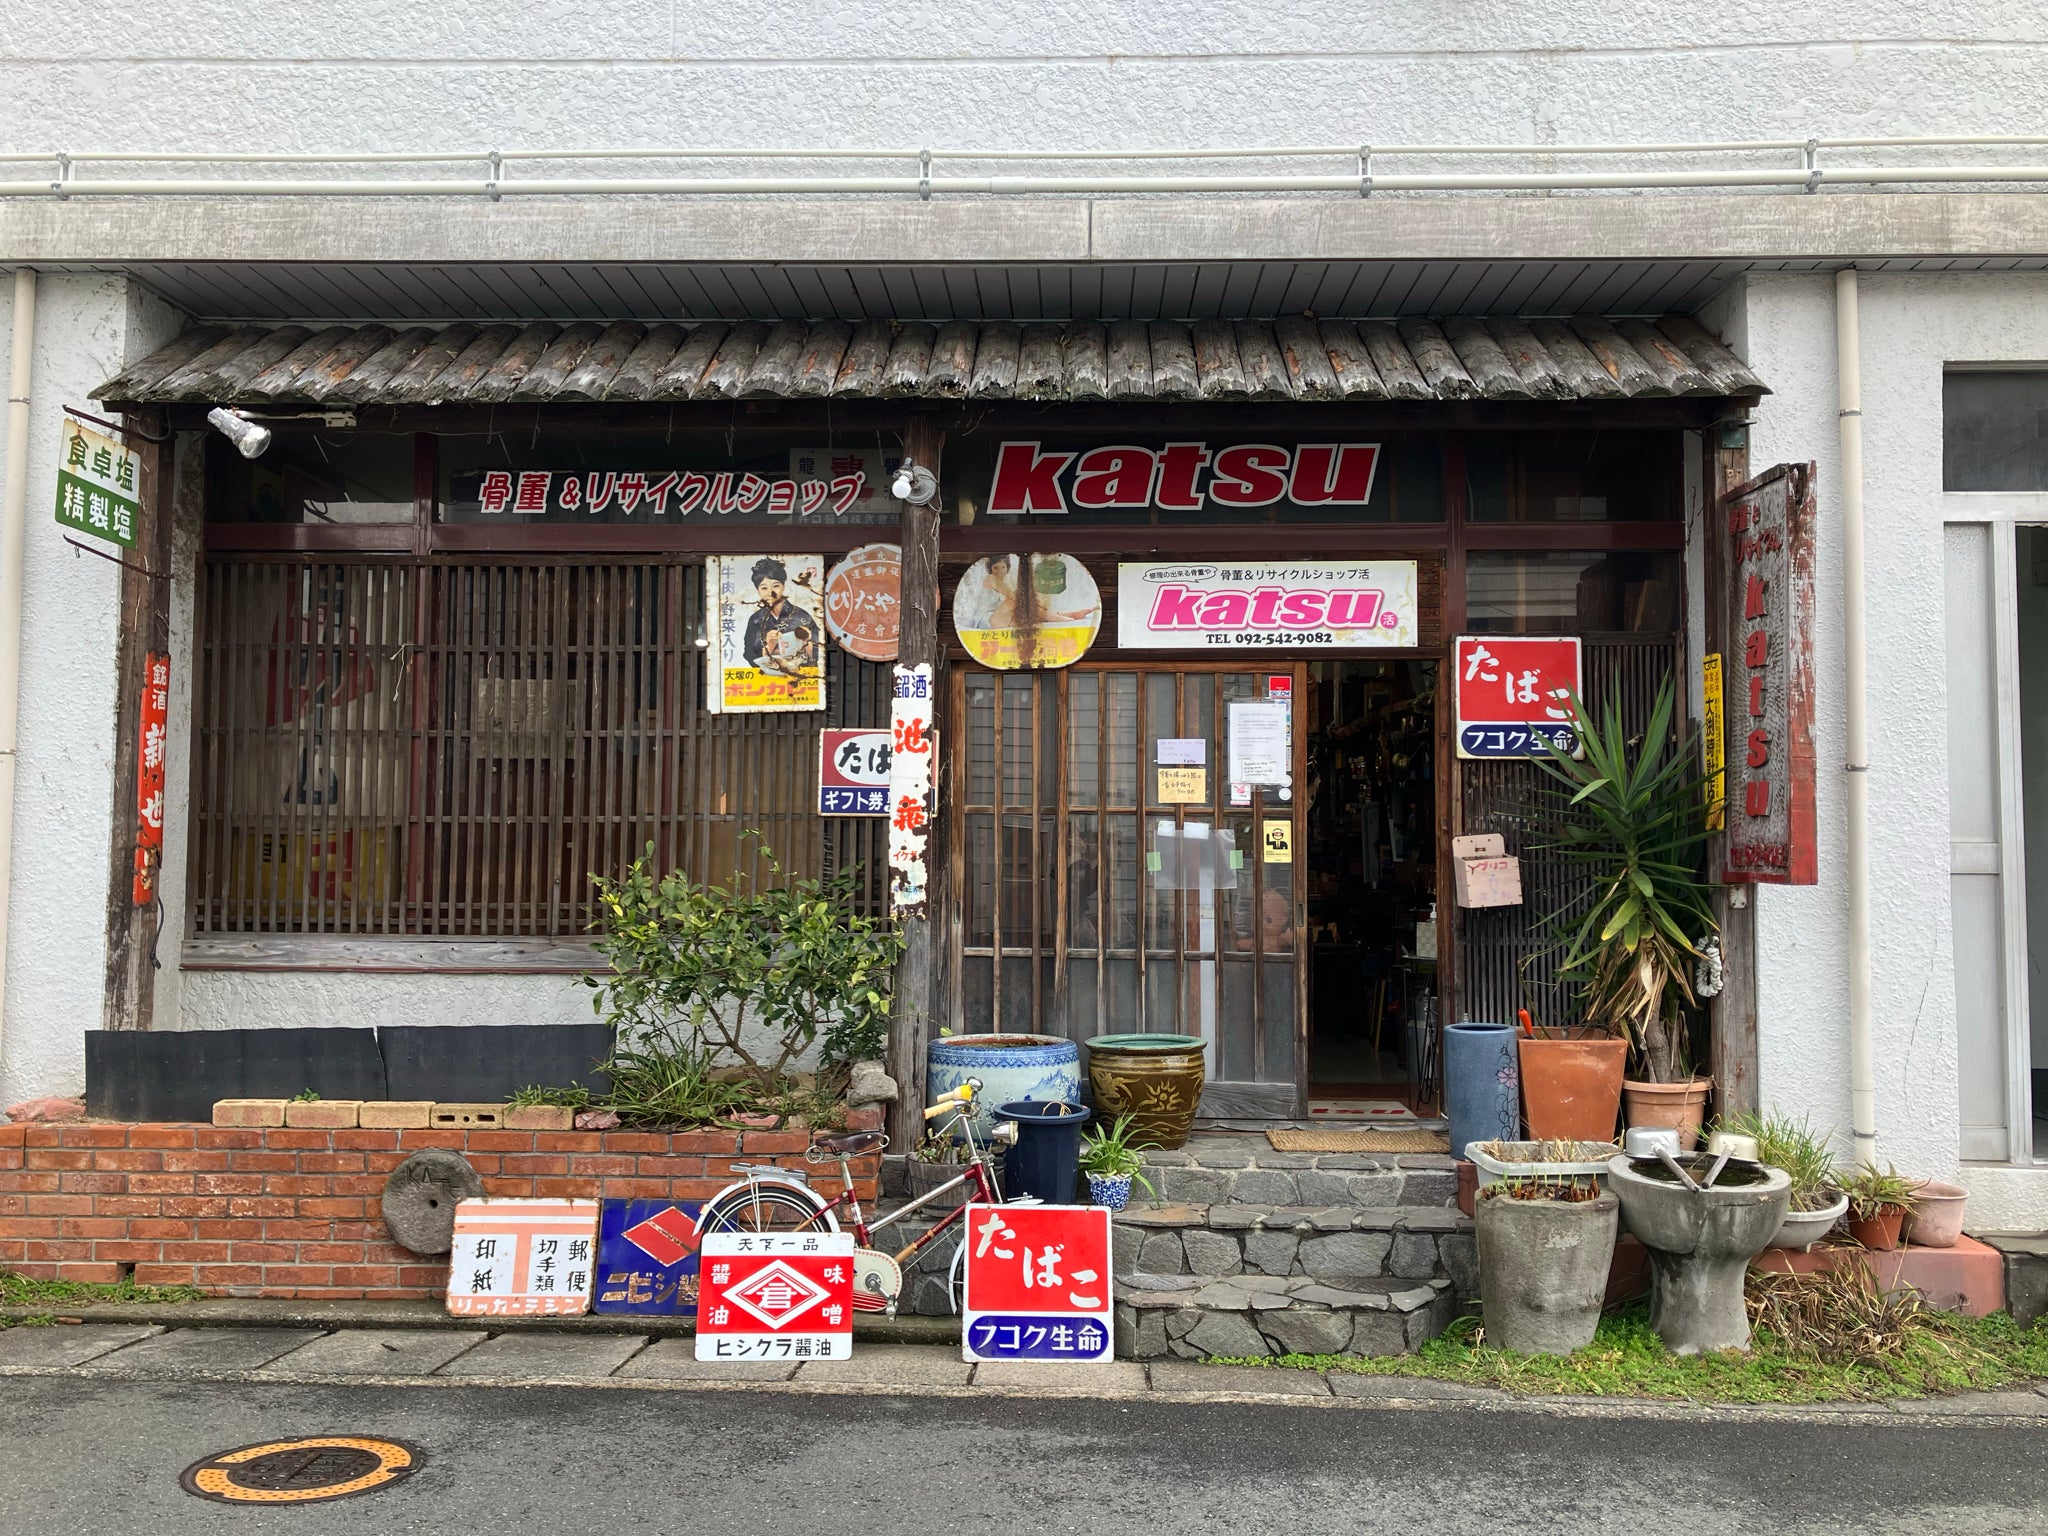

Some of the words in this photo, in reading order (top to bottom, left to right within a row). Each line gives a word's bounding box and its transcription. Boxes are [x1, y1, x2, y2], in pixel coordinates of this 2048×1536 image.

[67, 434, 134, 492] 食卓塩
[987, 441, 1381, 514] katsu
[63, 482, 131, 540] 精製塩
[1149, 584, 1385, 630] katsu
[1206, 633, 1231, 644] TEL
[1236, 632, 1333, 645] 092-542-9082
[725, 671, 754, 680] 大塚の
[725, 682, 818, 697] ボンカレー
[896, 674, 927, 698] 銘酒
[1465, 645, 1573, 719] たばこ
[1746, 574, 1770, 818] katsu
[472, 1238, 496, 1291] 印紙
[535, 1239, 557, 1292] 切手類
[567, 1240, 588, 1292] 郵便
[738, 1238, 819, 1251] 天下一品
[975, 1212, 1102, 1309] たばこ
[455, 1297, 579, 1315] リッカーミシン
[821, 1264, 846, 1325] 味噌
[716, 1338, 831, 1357] ヒシクラ醤油
[975, 1324, 1103, 1352] フコク生命
